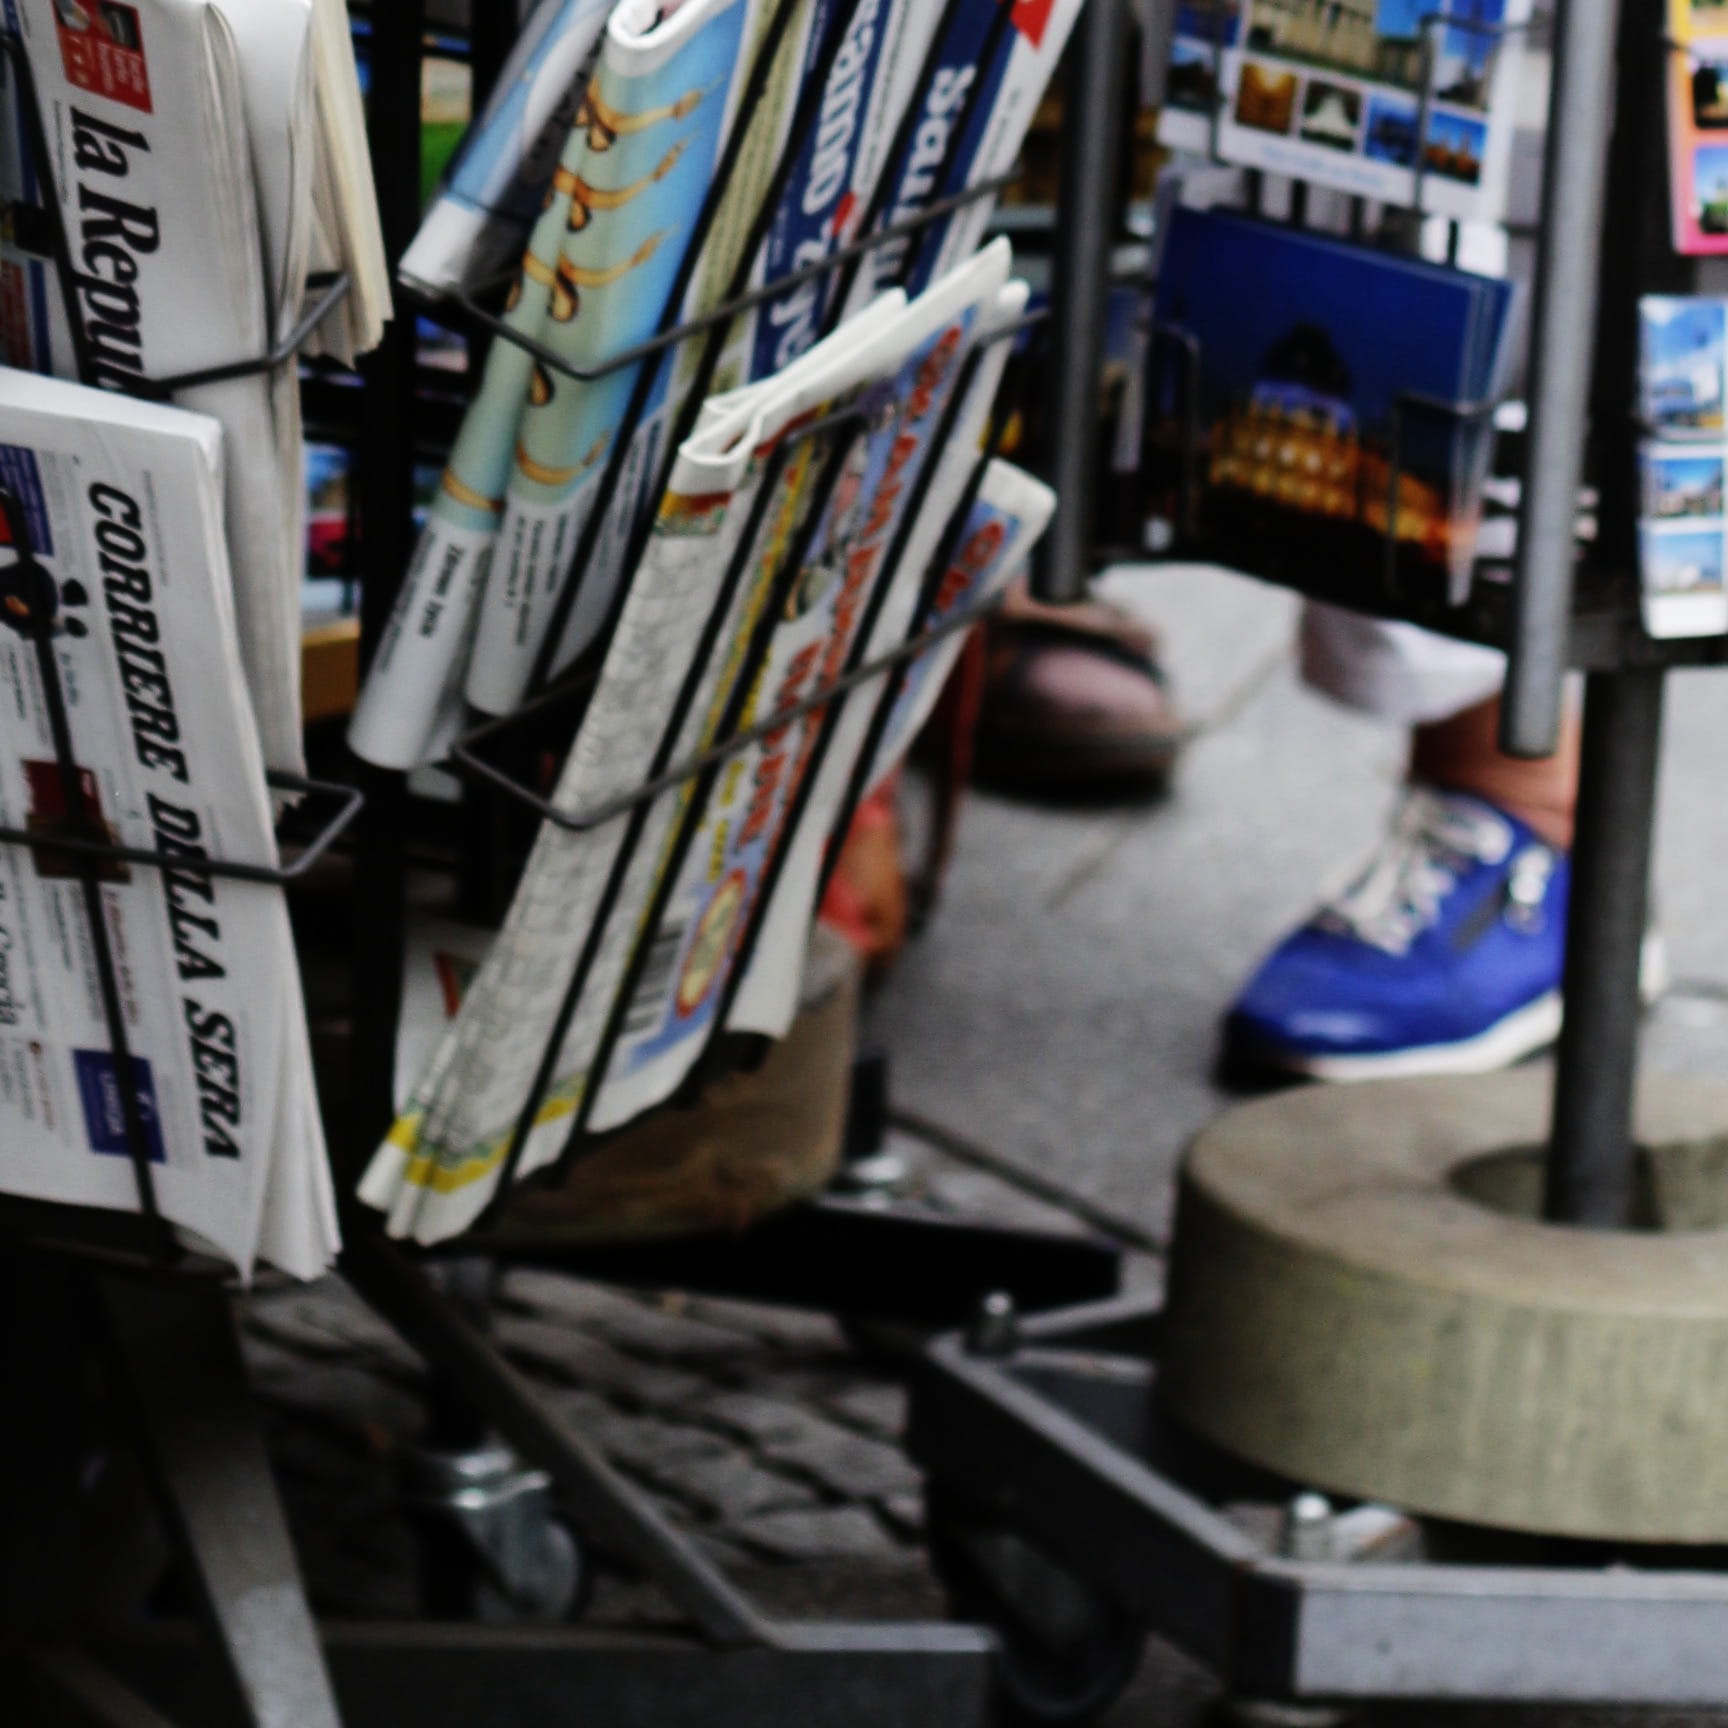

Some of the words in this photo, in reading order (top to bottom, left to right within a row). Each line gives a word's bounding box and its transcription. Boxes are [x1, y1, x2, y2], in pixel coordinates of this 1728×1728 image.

[71, 106, 153, 180] la
[87, 481, 192, 781] CORRIERE
[146, 794, 228, 984] DELLA
[184, 999, 242, 1163] SERA
